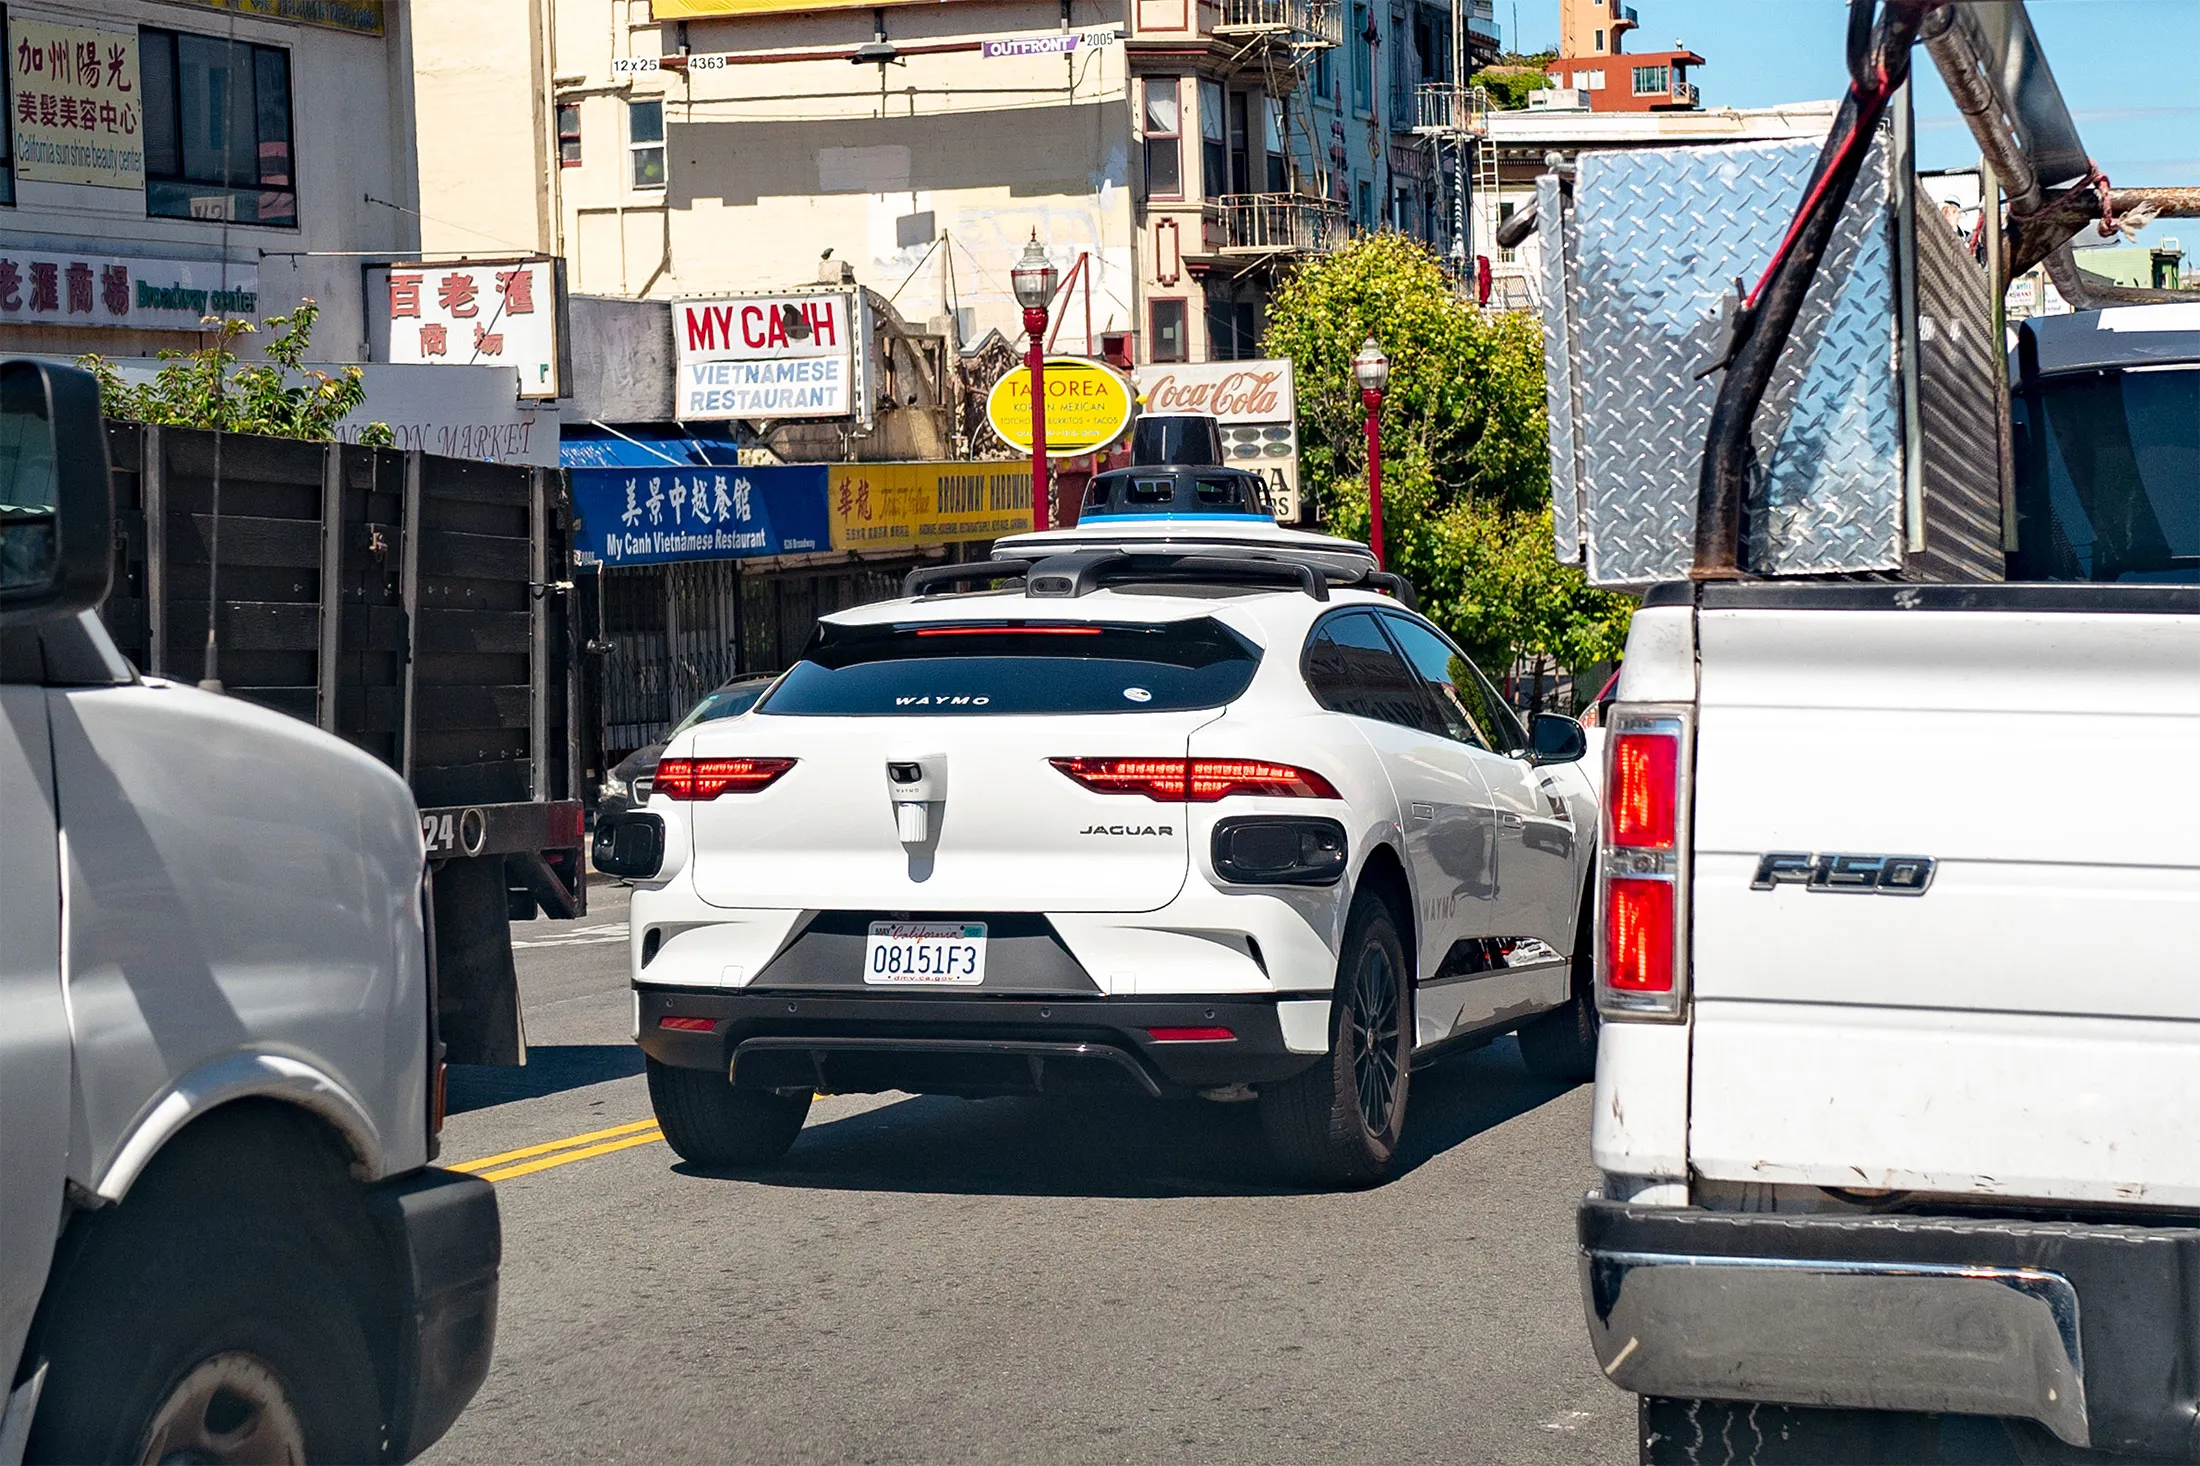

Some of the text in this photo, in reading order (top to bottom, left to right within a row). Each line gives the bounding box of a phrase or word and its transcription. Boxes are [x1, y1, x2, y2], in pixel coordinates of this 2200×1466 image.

[990, 37, 1072, 56] OUTFRONT
[1086, 32, 1113, 46] 2005
[18, 36, 132, 92] 加州陽光
[689, 57, 724, 69] 4363
[17, 90, 137, 134] 美髮美容中心
[17, 133, 55, 164] California
[92, 140, 118, 177] beauty
[119, 145, 142, 173] center
[135, 280, 208, 317] Broadway
[685, 302, 836, 351] MY CAH
[692, 360, 839, 385] VIETNAMESE
[690, 387, 838, 411] RESTAURANT
[1009, 380, 1109, 397] TAOREA
[1145, 371, 1283, 415] Coca-Cola
[1060, 403, 1105, 412] MEXICAN
[1094, 416, 1118, 424] TACOS
[437, 417, 536, 459] MARKET
[621, 475, 752, 527] 美景中越餐館
[938, 475, 985, 513] BROADWAY
[607, 533, 622, 560] My
[625, 532, 651, 555] Canh
[715, 528, 766, 549] Restaurant
[895, 696, 990, 706] WAYMO
[1079, 825, 1174, 836] JAGUAR
[1422, 895, 1456, 921] WAYMO
[892, 925, 964, 944] California
[873, 945, 977, 974] 08151F3
